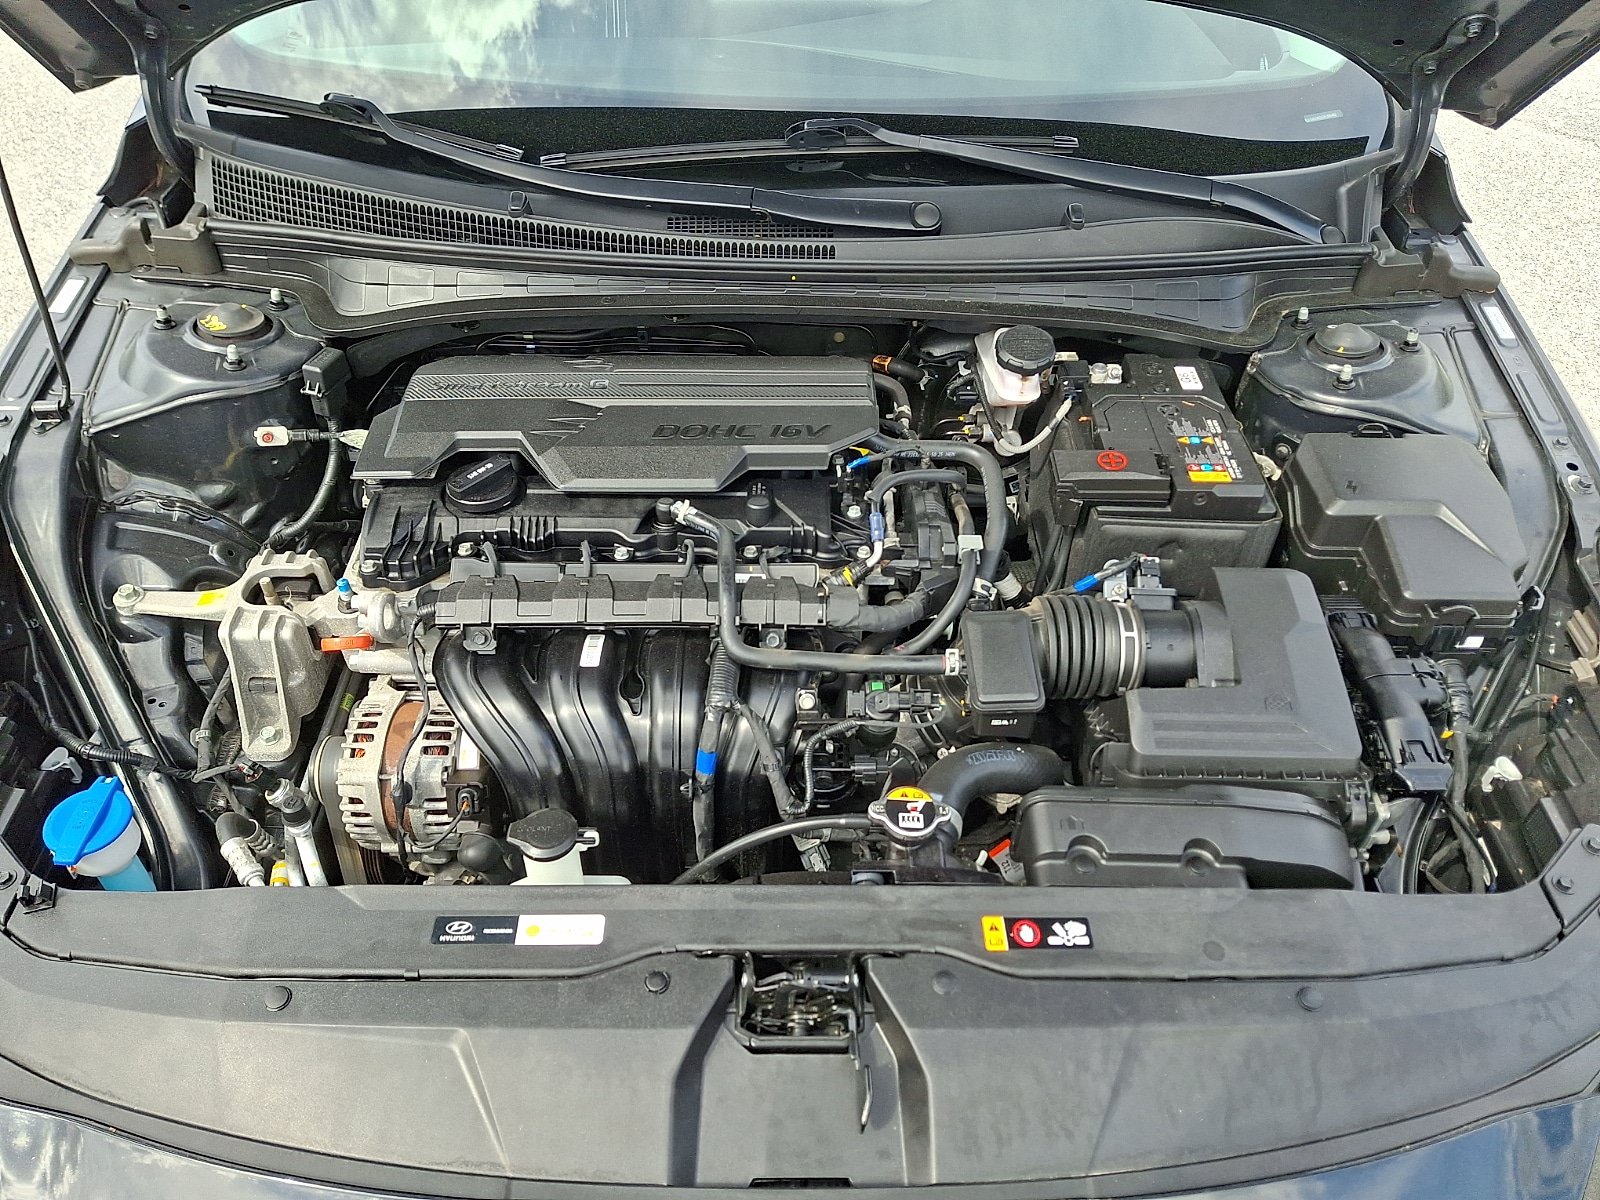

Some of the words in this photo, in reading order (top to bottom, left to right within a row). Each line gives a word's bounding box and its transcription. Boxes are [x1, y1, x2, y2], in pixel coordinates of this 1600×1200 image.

[428, 379, 583, 391] Smartstream
[589, 378, 609, 390] G
[652, 424, 761, 439] DOHC
[769, 424, 831, 439] 16V
[938, 806, 950, 815] 1.1
[439, 934, 475, 942] HYUNDAI
